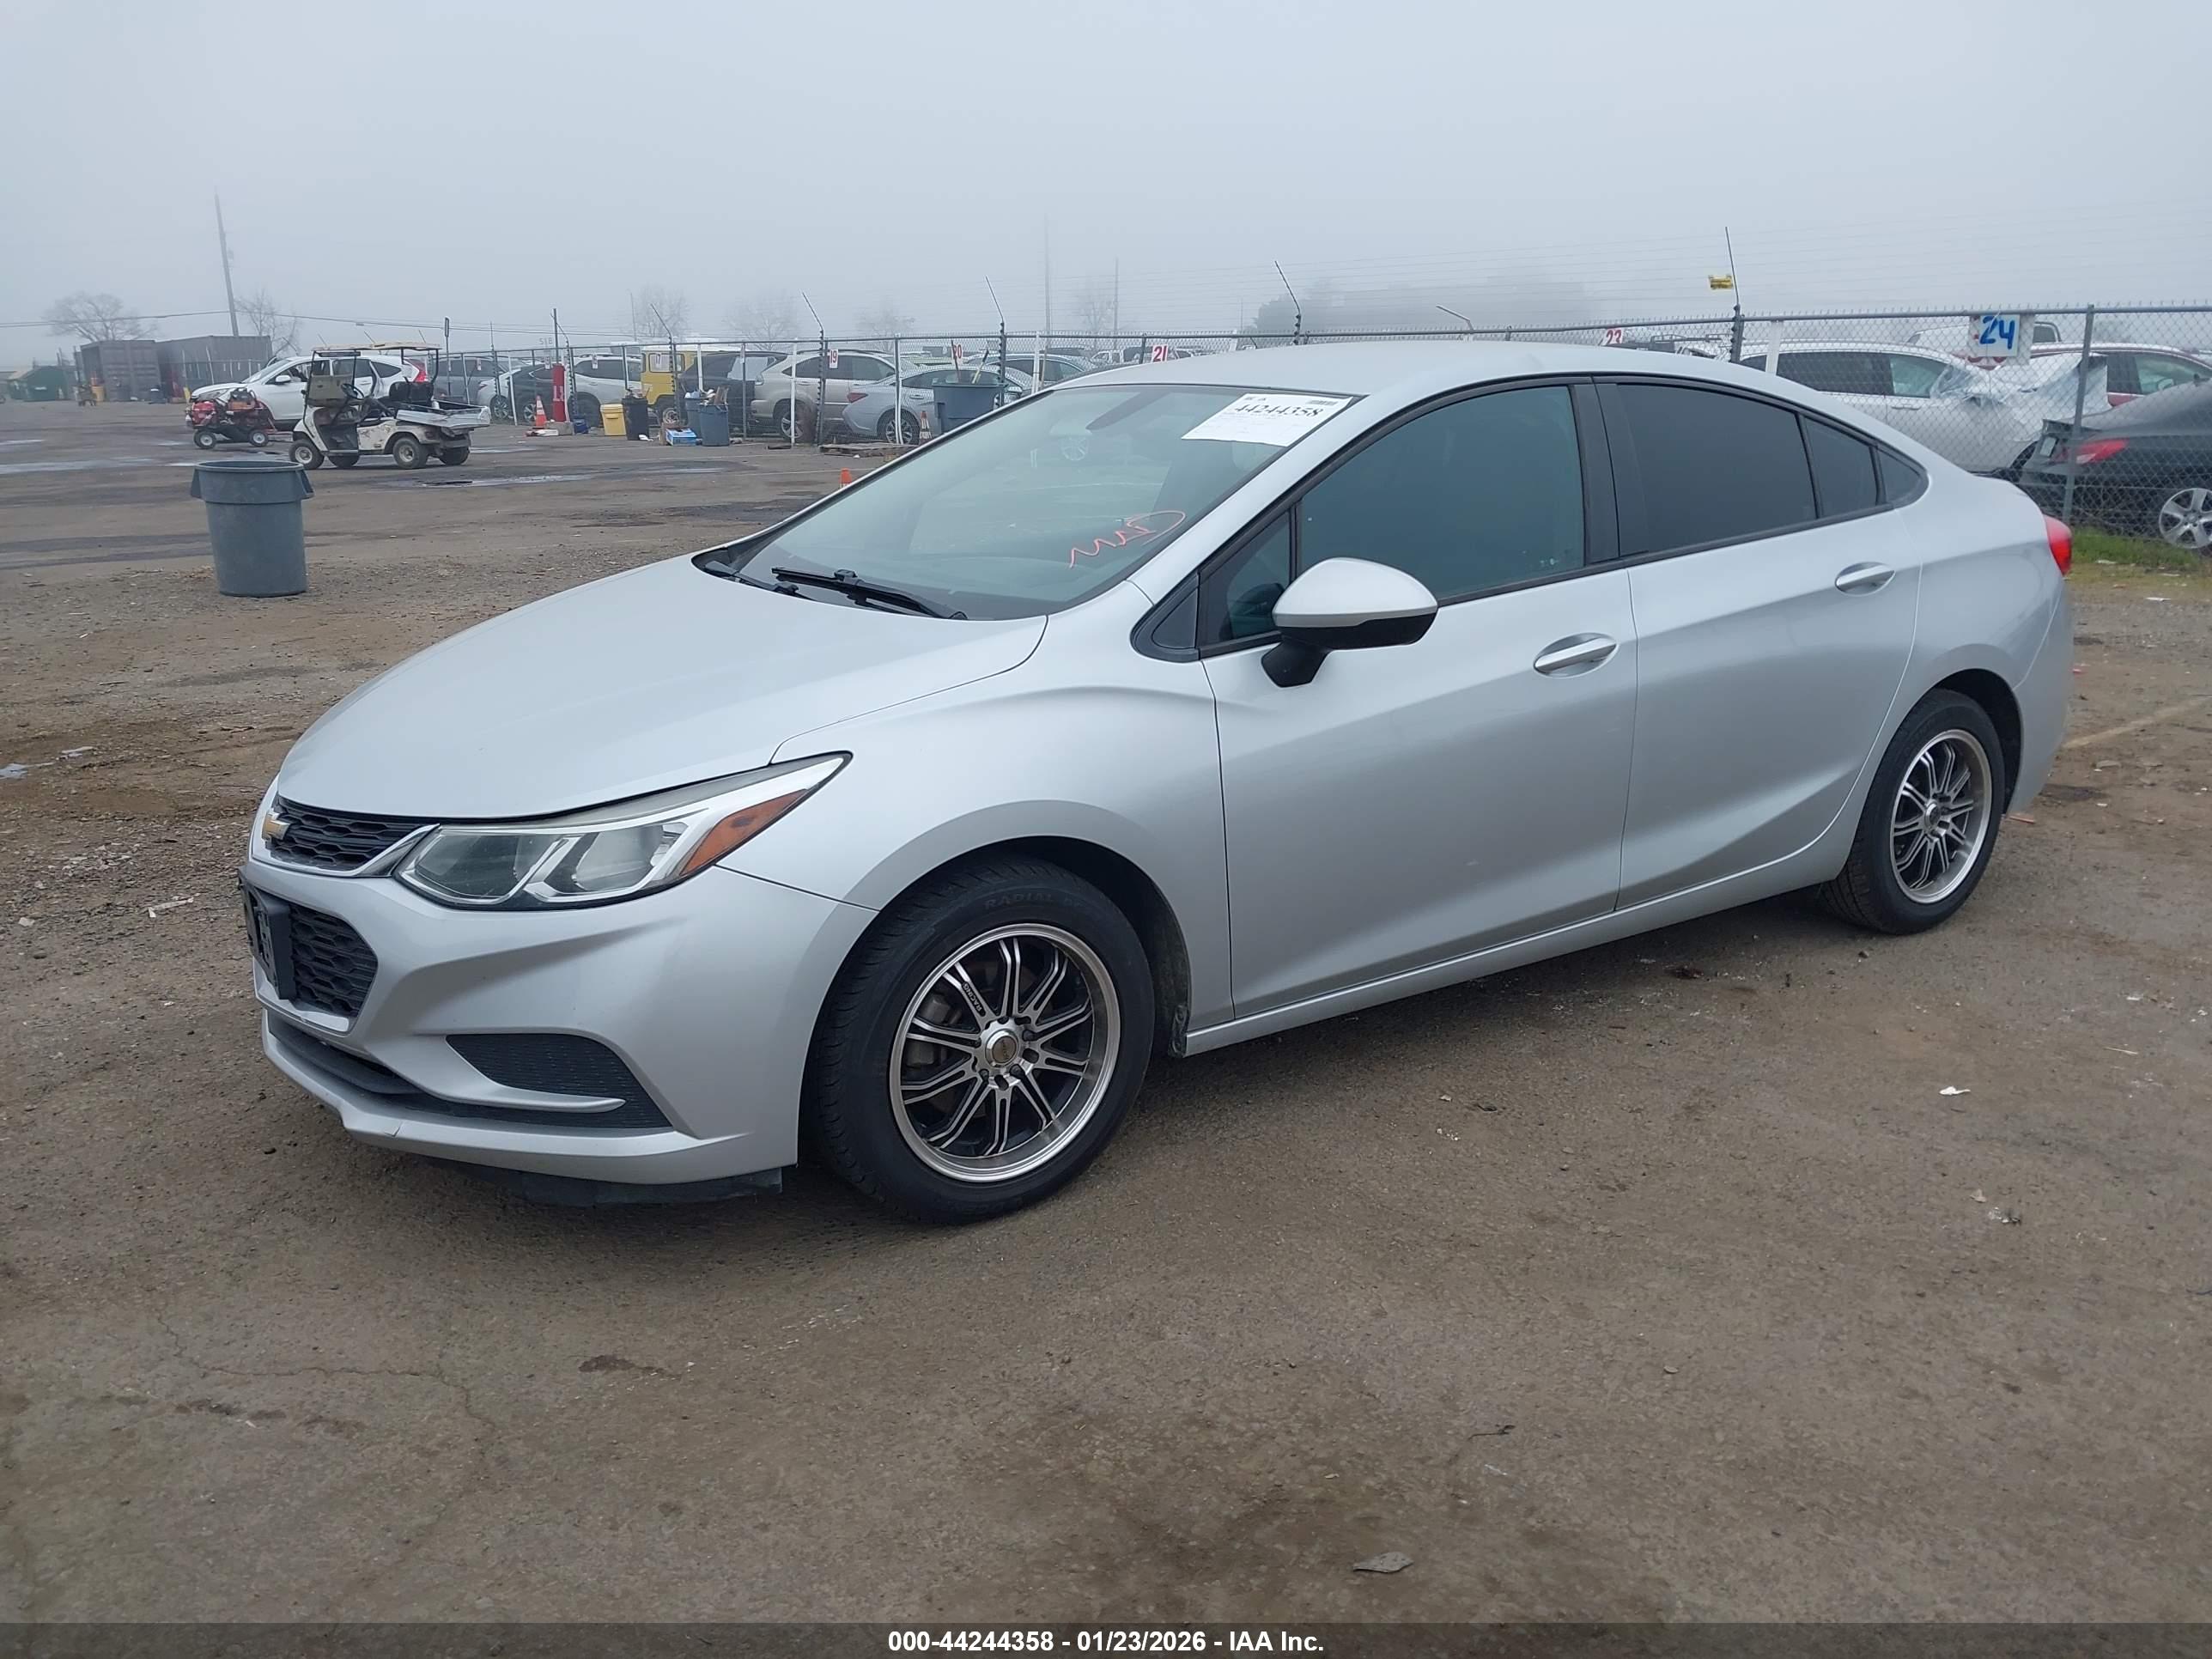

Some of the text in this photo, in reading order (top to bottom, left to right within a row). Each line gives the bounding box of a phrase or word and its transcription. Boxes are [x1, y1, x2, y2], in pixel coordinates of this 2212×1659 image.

[1978, 315, 2016, 350] 24
[1152, 345, 1167, 362] 21
[1234, 403, 1324, 418] 44244358
[962, 982, 983, 1012] RACING
